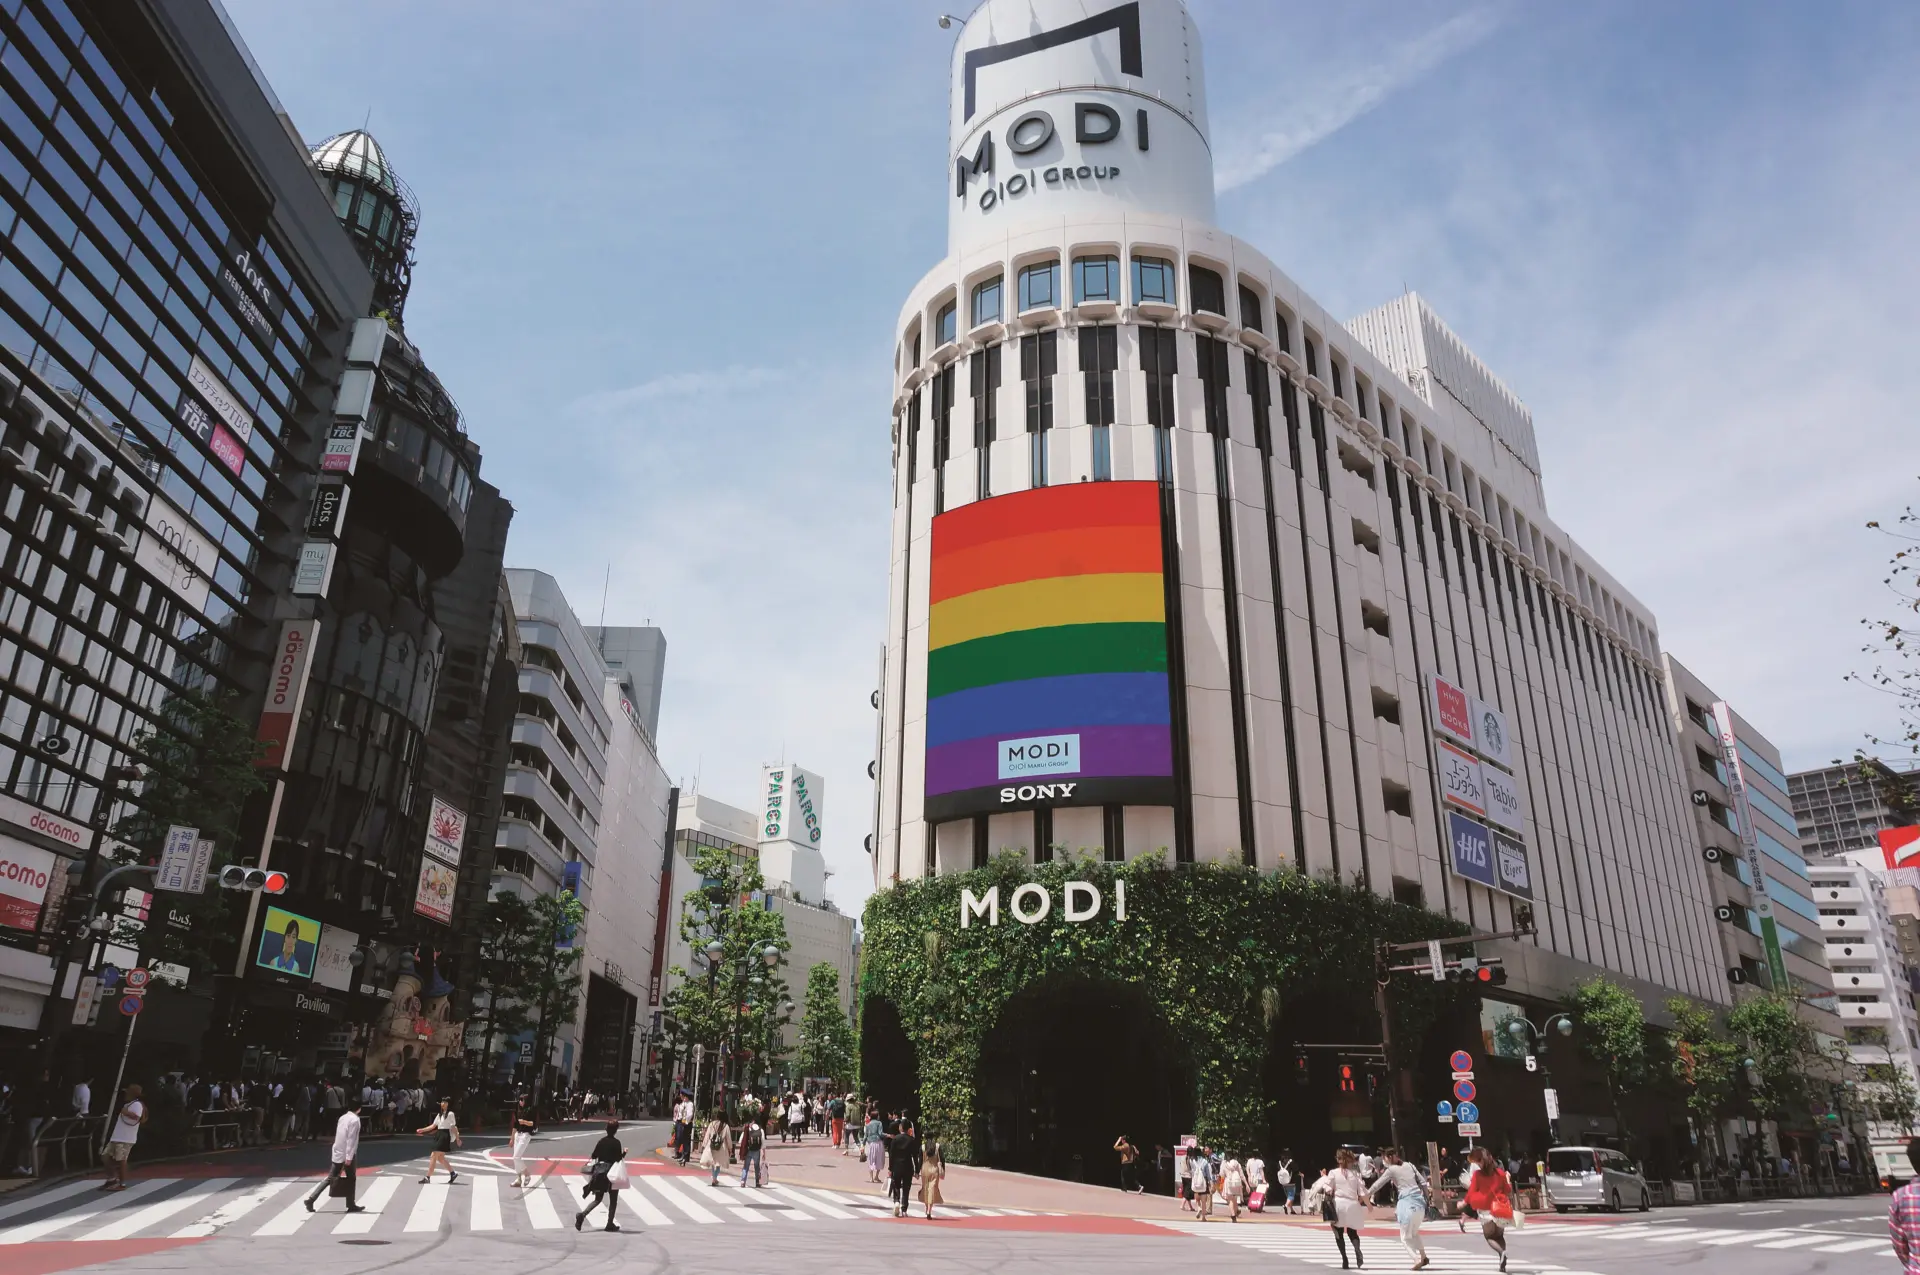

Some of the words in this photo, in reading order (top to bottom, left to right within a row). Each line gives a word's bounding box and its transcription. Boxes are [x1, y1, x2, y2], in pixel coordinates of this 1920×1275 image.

[957, 102, 1149, 198] MODI
[1043, 165, 1121, 184] GROUP
[180, 403, 209, 440] TBC
[333, 429, 355, 438] TBC
[214, 439, 240, 468] epiler
[329, 444, 352, 453] TBC
[274, 630, 304, 705] docomo
[1442, 690, 1460, 705] HMV
[1441, 711, 1468, 732] BOOKS
[1009, 742, 1069, 761] MODI
[1452, 759, 1471, 781] エース
[1726, 746, 1742, 792] 日本生命
[1000, 783, 1077, 803] SONY
[1446, 772, 1480, 800] コンタクト
[1487, 778, 1518, 810] Tabio
[765, 771, 784, 836] PARCO
[793, 773, 822, 843] PARCO
[30, 811, 80, 843] docomo
[169, 830, 194, 887] 神南一丁目
[1503, 859, 1523, 878] Tiger
[961, 880, 1126, 928] MODI
[131, 973, 145, 982] 30
[295, 993, 331, 1015] Pavilion
[1525, 1055, 1537, 1071] 5
[1461, 1107, 1470, 1120] P
